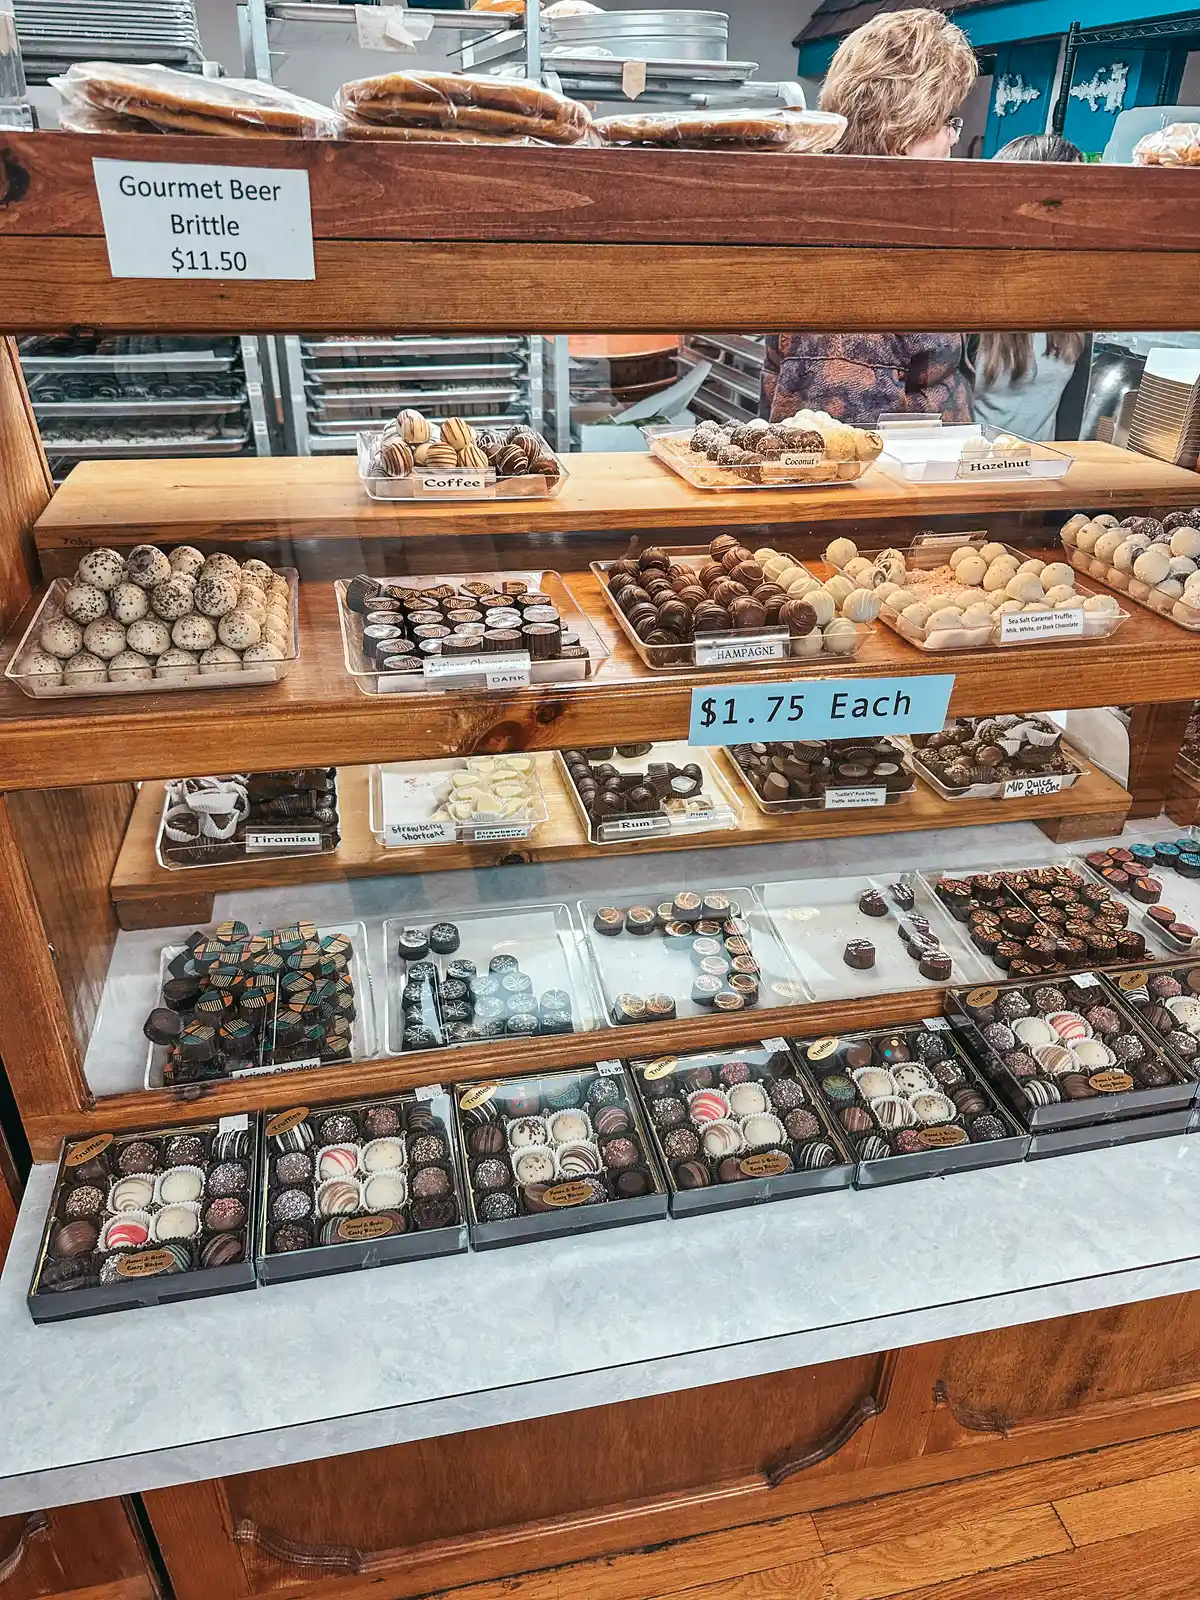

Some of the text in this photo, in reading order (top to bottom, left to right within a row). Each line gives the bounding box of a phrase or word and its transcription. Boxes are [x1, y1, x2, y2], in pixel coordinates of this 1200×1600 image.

[119, 175, 281, 201] Gourmet Beer
[170, 214, 240, 236] Brittle
[171, 247, 247, 273] $11.50
[785, 458, 814, 466] Coconut
[970, 460, 1031, 471] Hazelnut
[424, 478, 481, 487] Coffee
[1031, 614, 1053, 622] Caramel
[1055, 612, 1073, 620] Truffle
[1055, 621, 1079, 629] Chocolate
[492, 675, 525, 683] DARK
[699, 690, 911, 727] $1.75 Each
[621, 820, 650, 829] Rum
[251, 835, 316, 843] Tiramisu
[812, 1040, 834, 1057] Truffles
[649, 1058, 673, 1076] Truffles
[465, 1085, 492, 1105] Truffles
[271, 1111, 302, 1132] Truffles
[72, 1138, 105, 1161] Truffles
